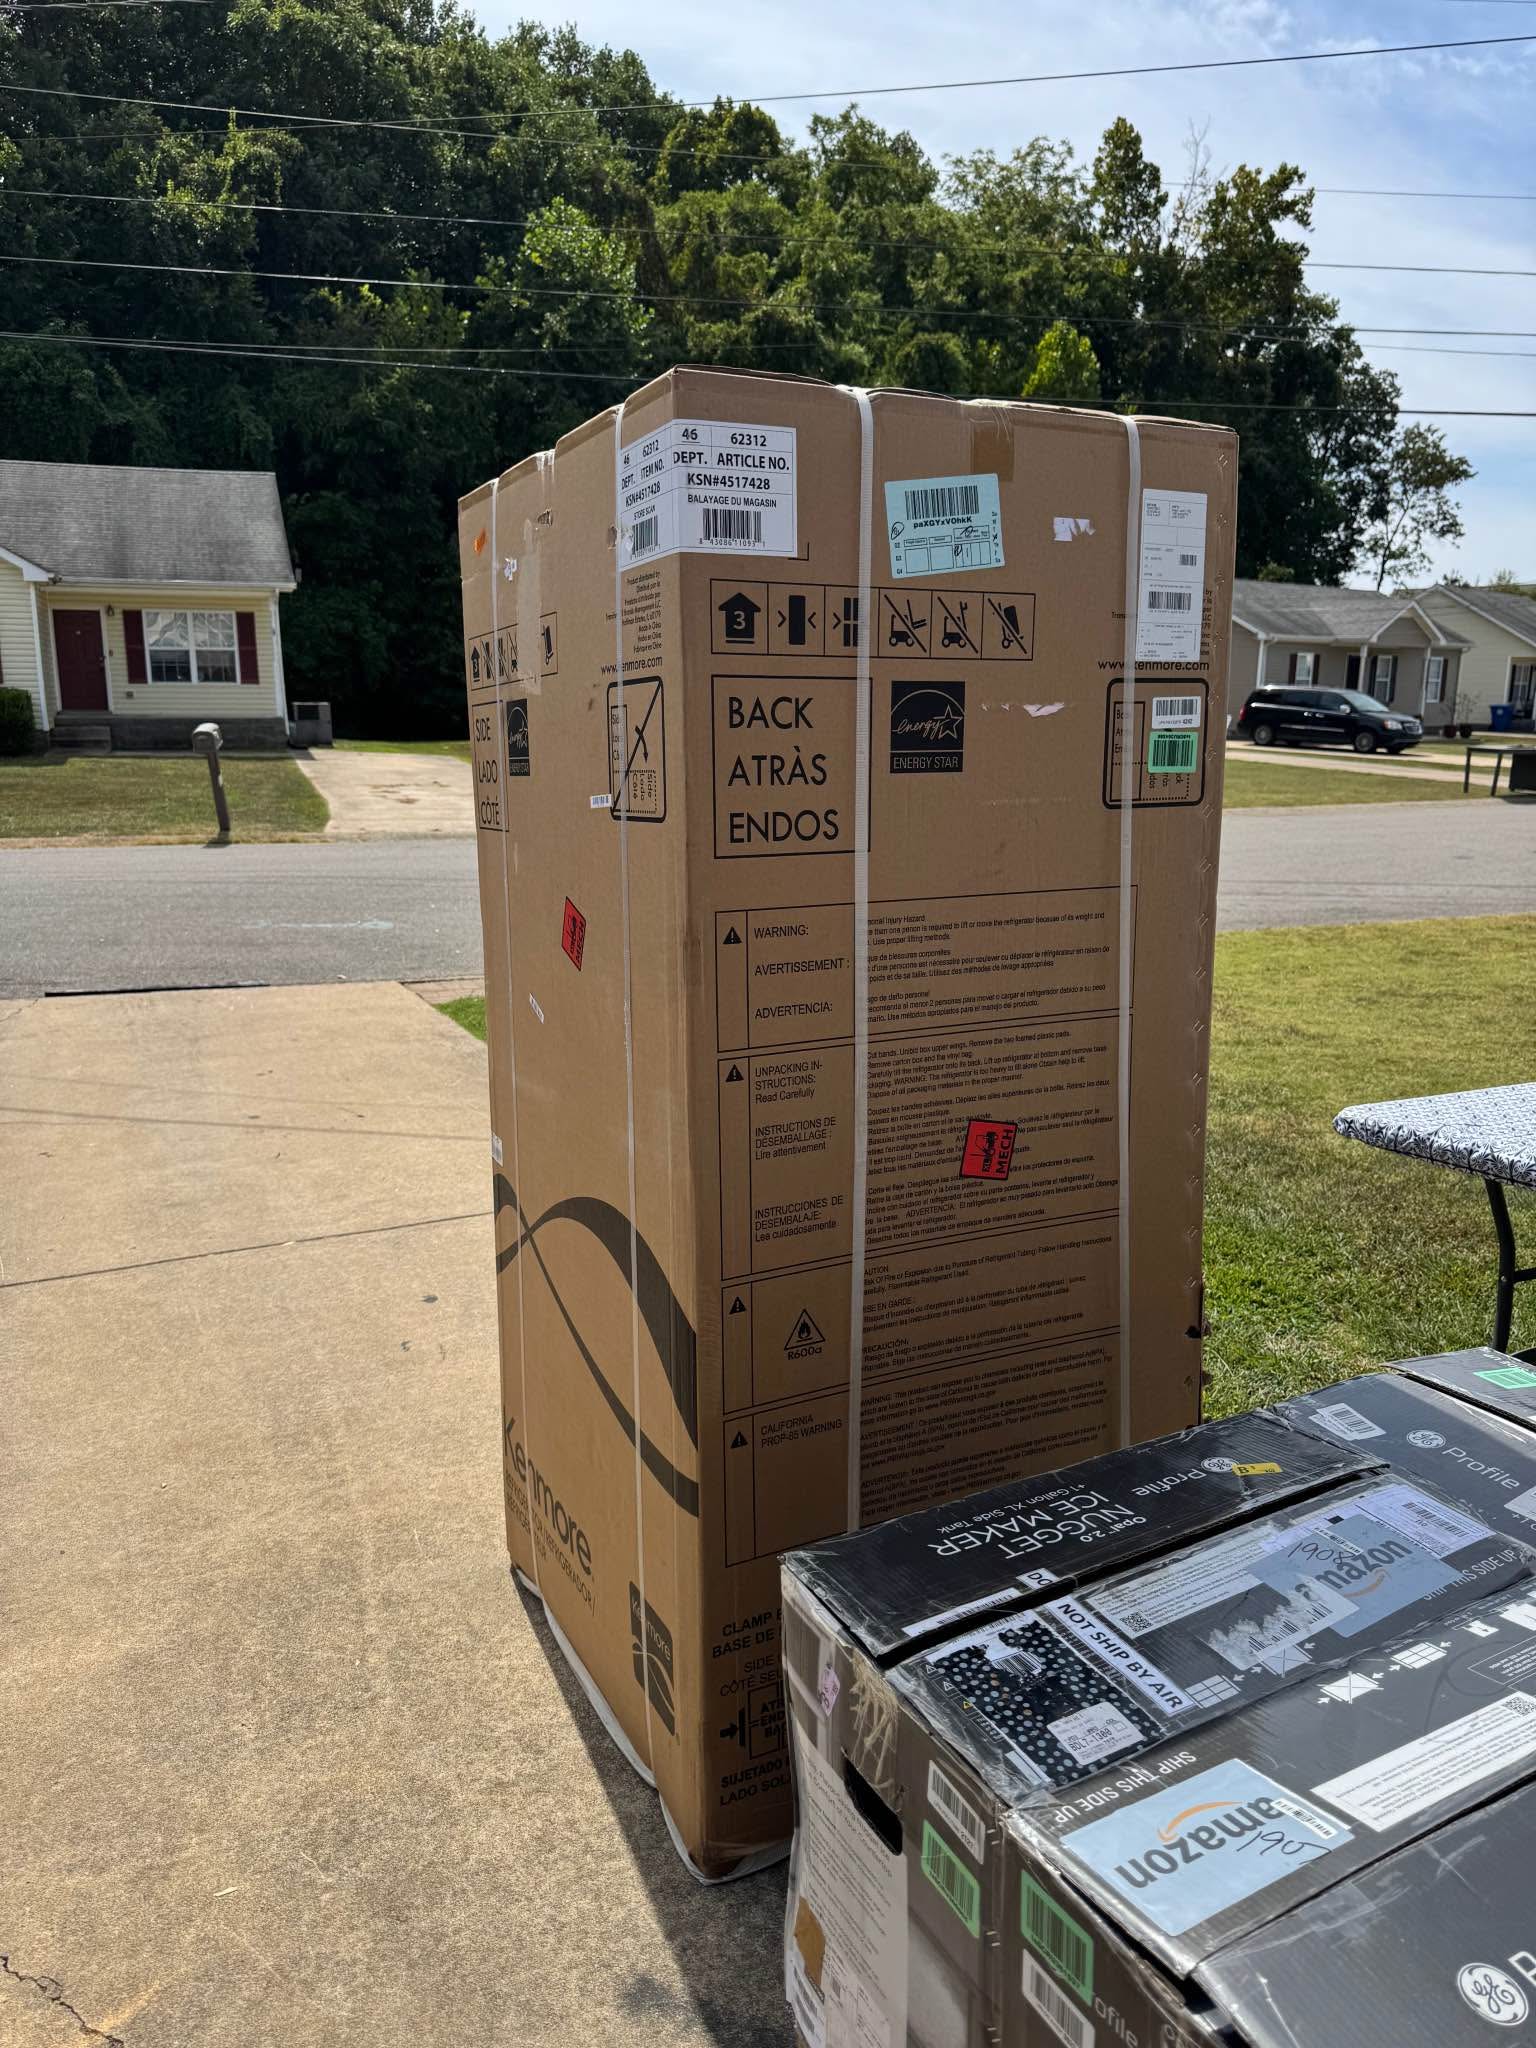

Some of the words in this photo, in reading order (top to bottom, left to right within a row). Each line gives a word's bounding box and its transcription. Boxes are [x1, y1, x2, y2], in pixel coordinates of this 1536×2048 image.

[682, 428, 698, 441] 46
[730, 432, 767, 447] 62312
[623, 454, 630, 465] 46
[642, 440, 659, 458] 62312
[673, 451, 708, 465] DEPT.
[717, 452, 765, 469] ARTICLE
[768, 456, 790, 470] NO.
[622, 473, 636, 490] DEPT.
[640, 464, 654, 481] ITEM
[654, 458, 664, 472] NO.
[687, 472, 770, 490] KSN#4517428
[688, 494, 730, 505] BALAYAGE
[731, 496, 742, 506] DU
[744, 498, 777, 508] MAGASIN
[728, 696, 814, 729] BACK
[475, 718, 491, 742] SIDE
[478, 760, 498, 784] LADO
[728, 746, 828, 786] ATRÀS
[893, 756, 932, 770] ENERGY
[934, 756, 959, 768] STAR
[729, 808, 840, 844] ENDOS
[754, 924, 808, 939] WARNING:
[754, 958, 844, 976] AVERTISSEMENT
[754, 1002, 832, 1019] ADVERTENCIA:
[755, 1064, 809, 1078] UNPACKING
[810, 1061, 823, 1071] IN-
[755, 1075, 816, 1091] STRUCTIONS:
[755, 1092, 778, 1104] Read
[779, 1088, 815, 1102] Carefully
[755, 1119, 822, 1137] INSTRUCTIONS
[824, 1117, 836, 1126] DE
[755, 1130, 827, 1149] DESEMBALLAGE
[755, 1148, 771, 1160] Lire
[772, 1142, 826, 1157] attentivement
[996, 1129, 1014, 1173] MECH
[754, 1198, 828, 1219] INSTRUCCIONES
[831, 1196, 844, 1206] DE
[755, 1232, 771, 1242] Lea
[760, 1414, 814, 1436] CALIFORNIA
[801, 1418, 842, 1438] WARNING
[1441, 1446, 1521, 1490] Profile
[504, 1405, 592, 1576] Kenmore
[1130, 1468, 1208, 1496] Profile
[1003, 1502, 1028, 1512] XL
[1025, 1488, 1070, 1504] Gallon
[1049, 1490, 1110, 1516] ICE
[971, 1508, 1006, 1522] Side
[928, 1508, 1054, 1556] MAKER
[936, 1520, 975, 1535] Tank
[998, 1503, 1135, 1560] NUGGET
[1079, 1530, 1106, 1543] 2.0
[1472, 1557, 1505, 1576] SIDE
[1500, 1549, 1518, 1564] UP
[721, 1612, 772, 1637] CLAMP
[712, 1636, 752, 1658] BASE
[756, 1628, 776, 1644] DE
[744, 1654, 775, 1673] SIDE
[1058, 1602, 1094, 1632] NOT
[1090, 1632, 1130, 1661] SHIP
[1127, 1660, 1153, 1680] BY
[1147, 1675, 1184, 1709] AIR
[720, 1760, 783, 1788] SUJETADO
[1158, 1750, 1197, 1776] SHIP
[1116, 1765, 1162, 1794] THIS
[720, 1784, 758, 1806] LADO
[1076, 1788, 1120, 1812] SIDE
[1054, 1804, 1080, 1824] UP
[1114, 1795, 1286, 1890] amazon
